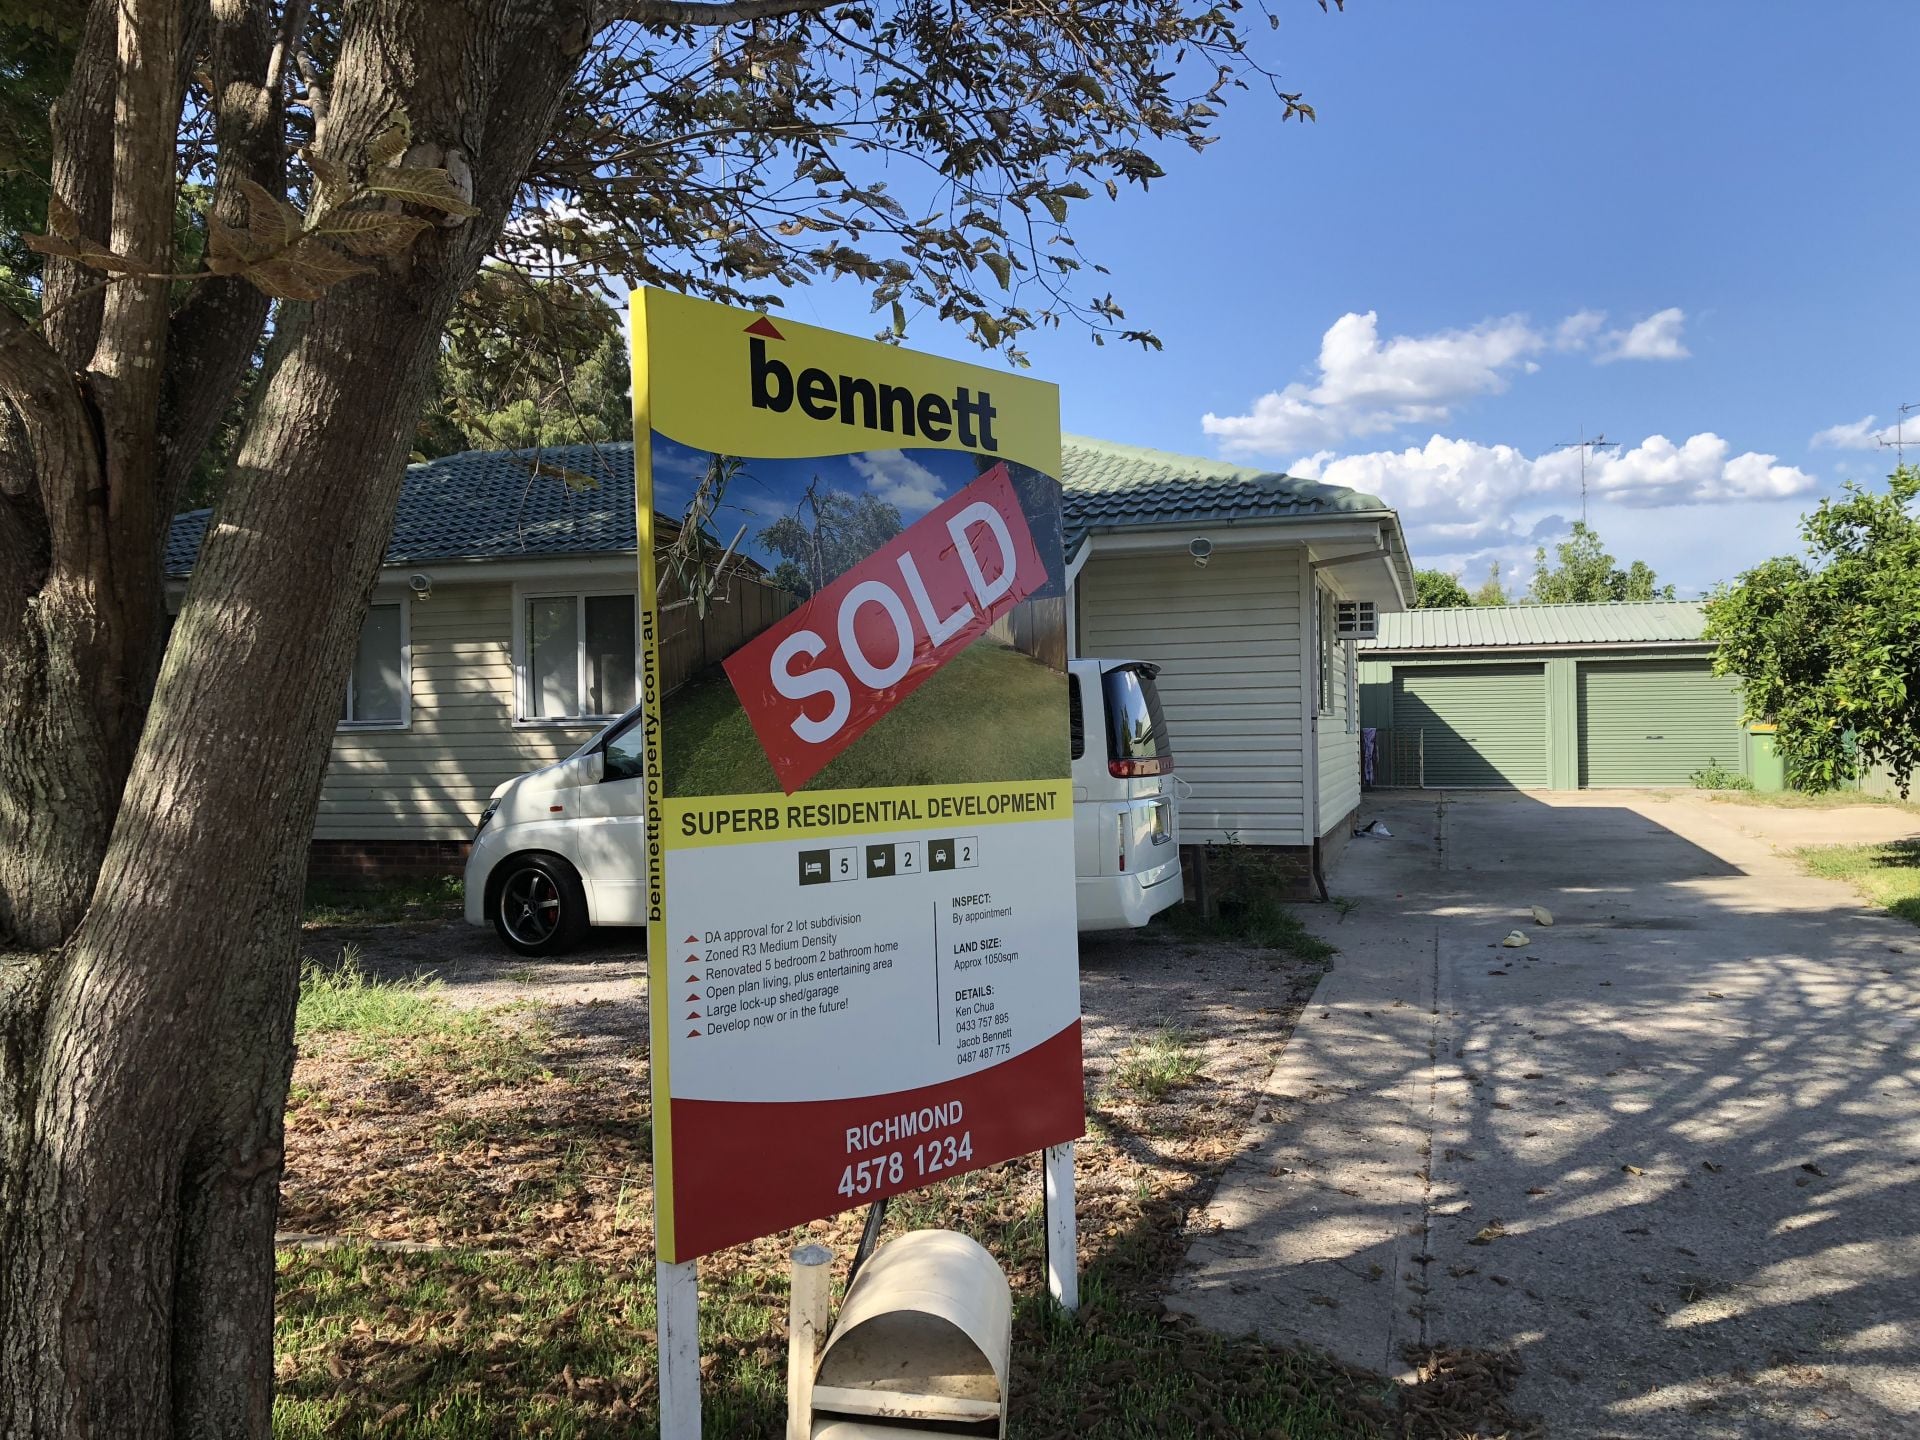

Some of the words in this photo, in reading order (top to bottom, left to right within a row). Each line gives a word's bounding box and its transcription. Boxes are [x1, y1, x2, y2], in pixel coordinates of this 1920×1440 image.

[749, 337, 998, 451] bennett
[769, 501, 1017, 744] SOLD
[643, 610, 662, 922] bennettproperty.com.au
[681, 807, 780, 837] SUPERB
[787, 799, 922, 829] RESIDENTIAL
[927, 791, 1058, 819] DEVELOPMENT
[840, 857, 849, 874] 5
[904, 852, 912, 868] 2
[963, 846, 971, 862] 2
[952, 893, 991, 908] INSPECT:
[952, 913, 963, 925] By
[965, 907, 1012, 922] appointment
[705, 931, 721, 944] DA
[724, 925, 768, 945] approval
[771, 922, 784, 935] for
[786, 921, 793, 933] 2
[796, 919, 808, 931] lot
[810, 913, 862, 929] subdivision
[705, 946, 739, 962] Zoned
[742, 944, 756, 957] R3
[760, 939, 799, 954] Medium
[802, 933, 837, 947] Density
[953, 941, 978, 954] LAND
[980, 938, 1002, 950] SIZE:
[706, 962, 762, 980] Renovated
[765, 959, 772, 971] 5
[774, 953, 817, 969] bedroom
[820, 951, 826, 962] 2
[829, 945, 872, 961] bathroom
[874, 941, 899, 953] home
[954, 956, 982, 972] Approx
[984, 951, 1019, 966] 1050sqm
[706, 985, 735, 1000] Open
[738, 979, 760, 996] plan
[763, 975, 792, 990] living,
[794, 972, 814, 986] plus
[816, 960, 870, 980] entertaining
[873, 959, 893, 971] area
[706, 1004, 737, 1017] Large
[740, 993, 777, 1012] lock-up
[779, 984, 839, 1004] shed/garage
[955, 985, 995, 1001] DETAILS:
[707, 1018, 750, 1035] Develop
[753, 1011, 774, 1026] now
[777, 1011, 788, 1023] or
[789, 1008, 799, 1019] in
[801, 1003, 816, 1018] the
[818, 997, 849, 1013] future!
[955, 1005, 972, 1017] Ken
[974, 1001, 995, 1013] Chua
[956, 1019, 976, 1033] 0433
[978, 1016, 993, 1027] 757
[994, 1012, 1009, 1024] 895
[956, 1034, 981, 1049] Jacob
[983, 1027, 1012, 1042] Bennett
[957, 1050, 977, 1064] 0487
[979, 1046, 994, 1059] 487
[996, 1043, 1011, 1054] 775
[846, 1100, 963, 1153] RICHMOND
[838, 1151, 904, 1198] 4578
[913, 1131, 973, 1176] 1234
